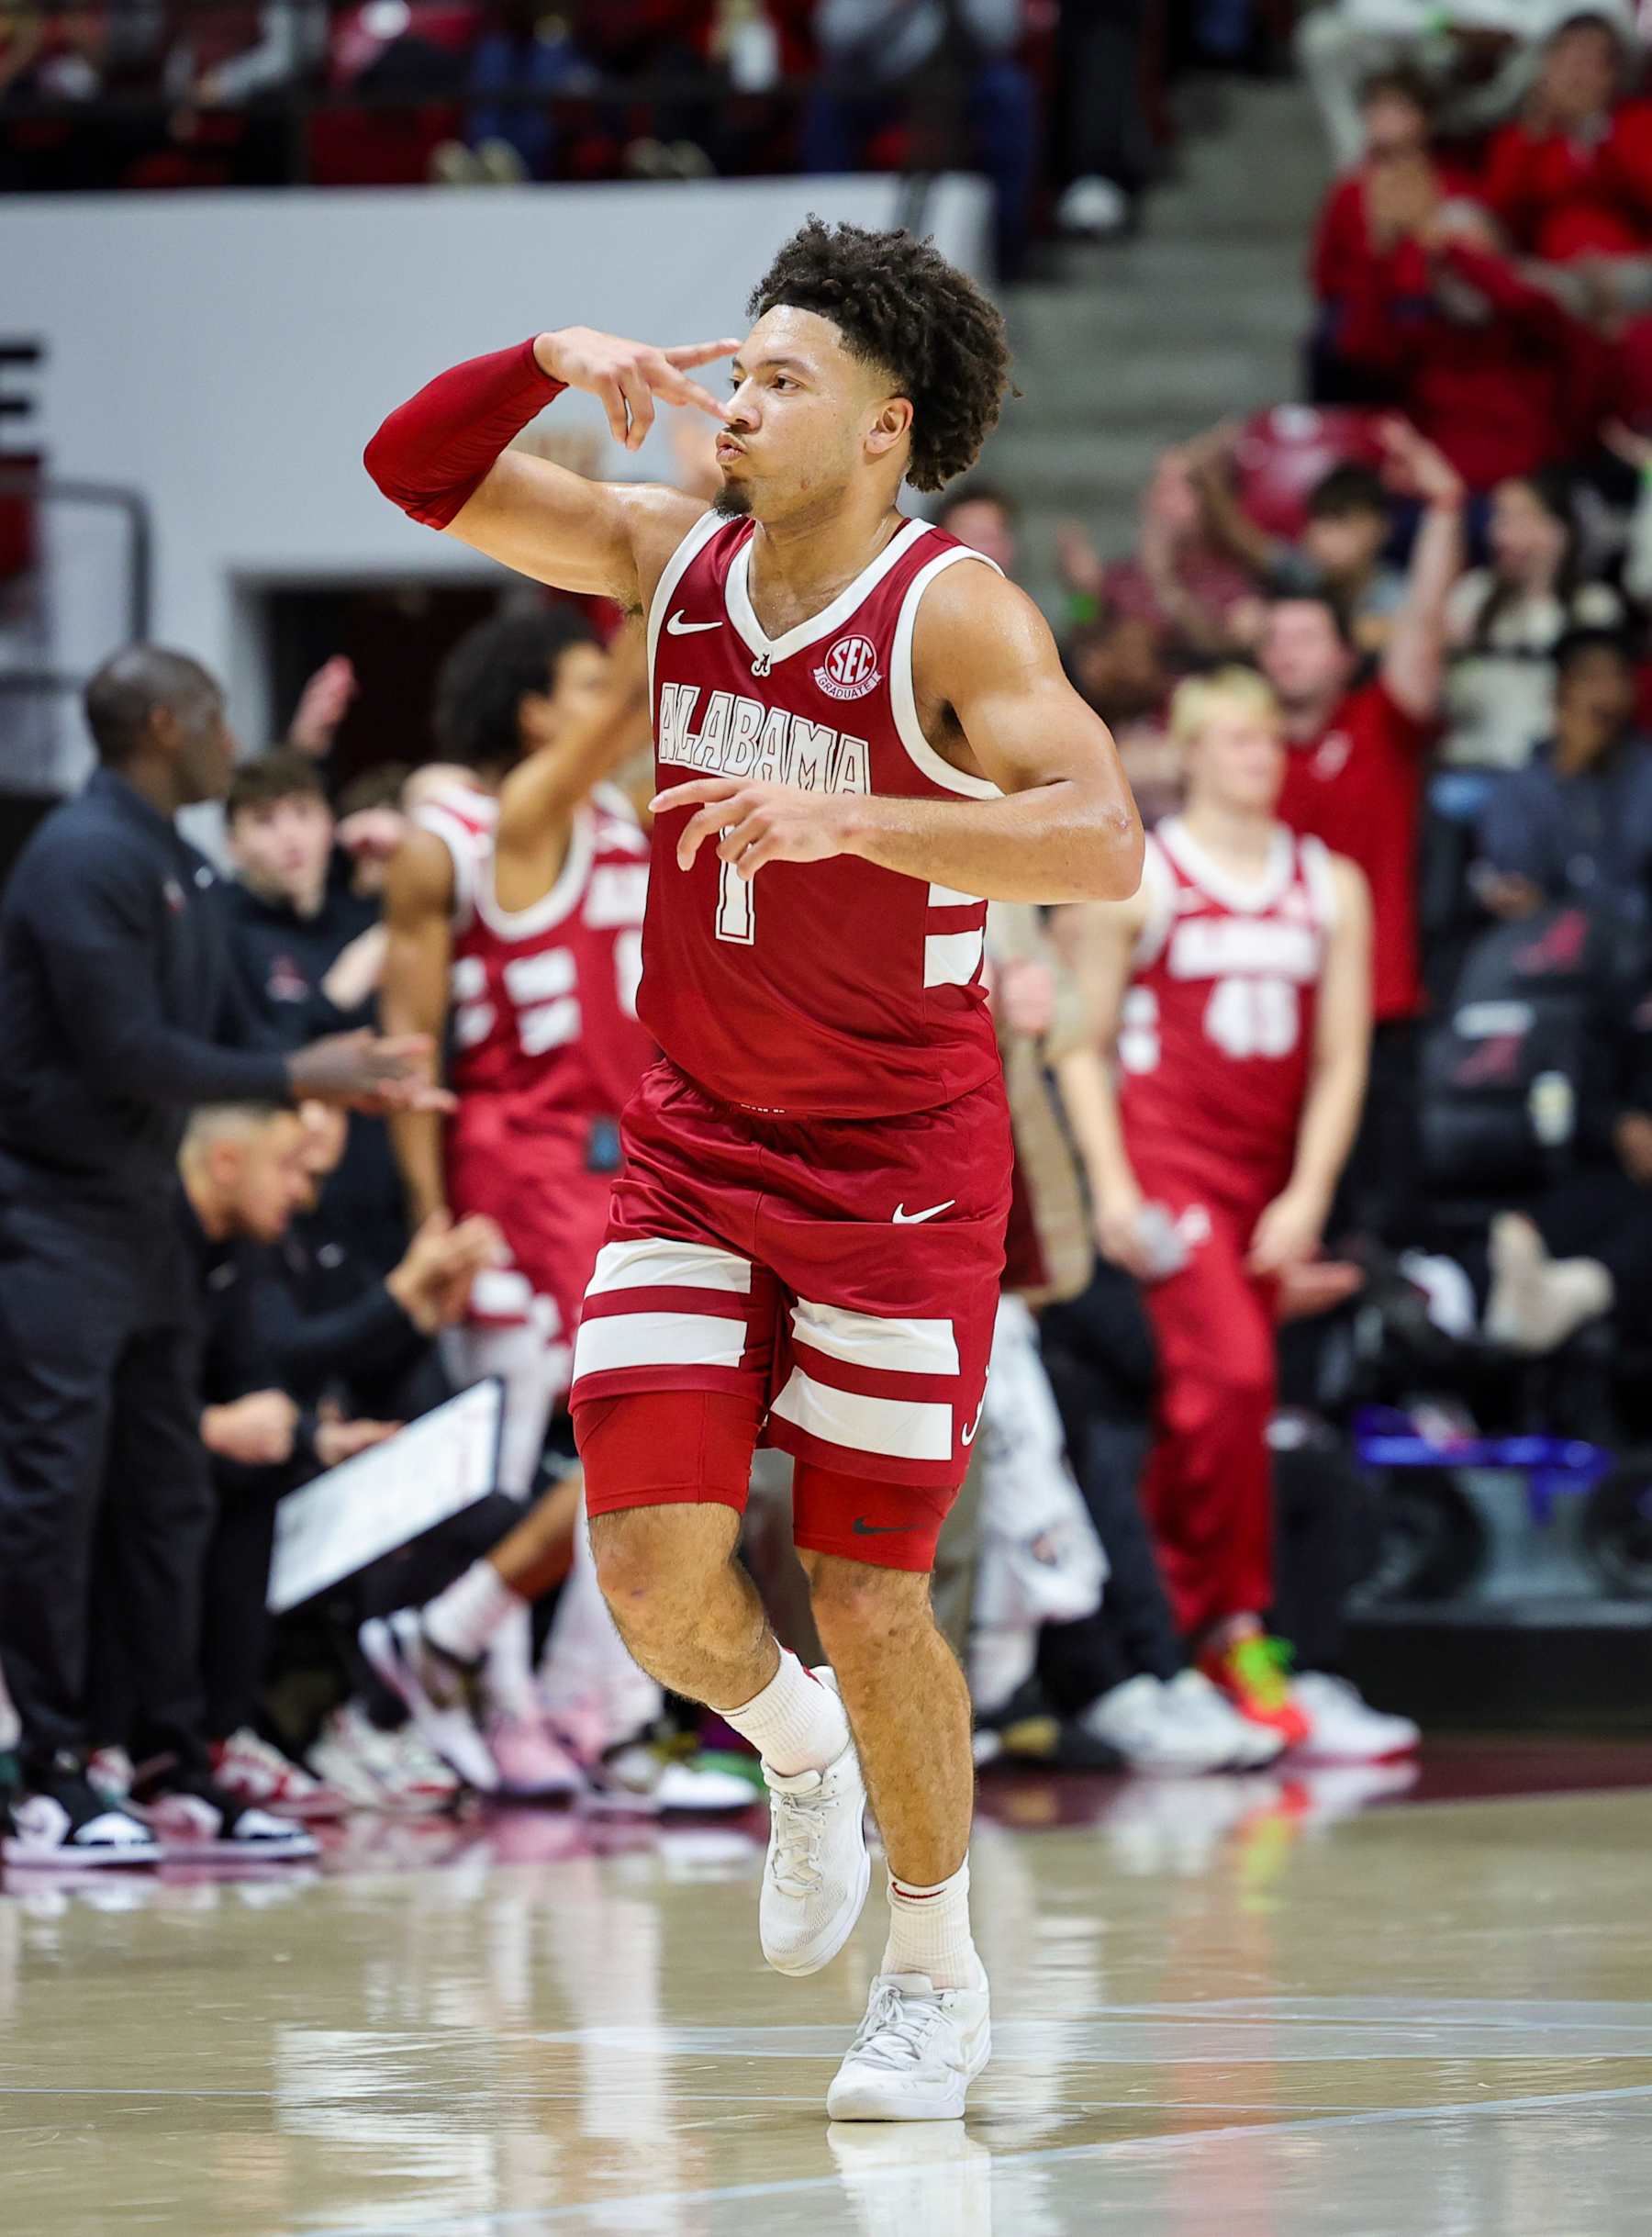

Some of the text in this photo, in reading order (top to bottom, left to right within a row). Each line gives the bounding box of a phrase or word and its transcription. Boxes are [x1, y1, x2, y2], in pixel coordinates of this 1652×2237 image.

[829, 637, 873, 685] SEC
[816, 676, 873, 700] GRADUATE
[658, 682, 871, 797] ALABAMA
